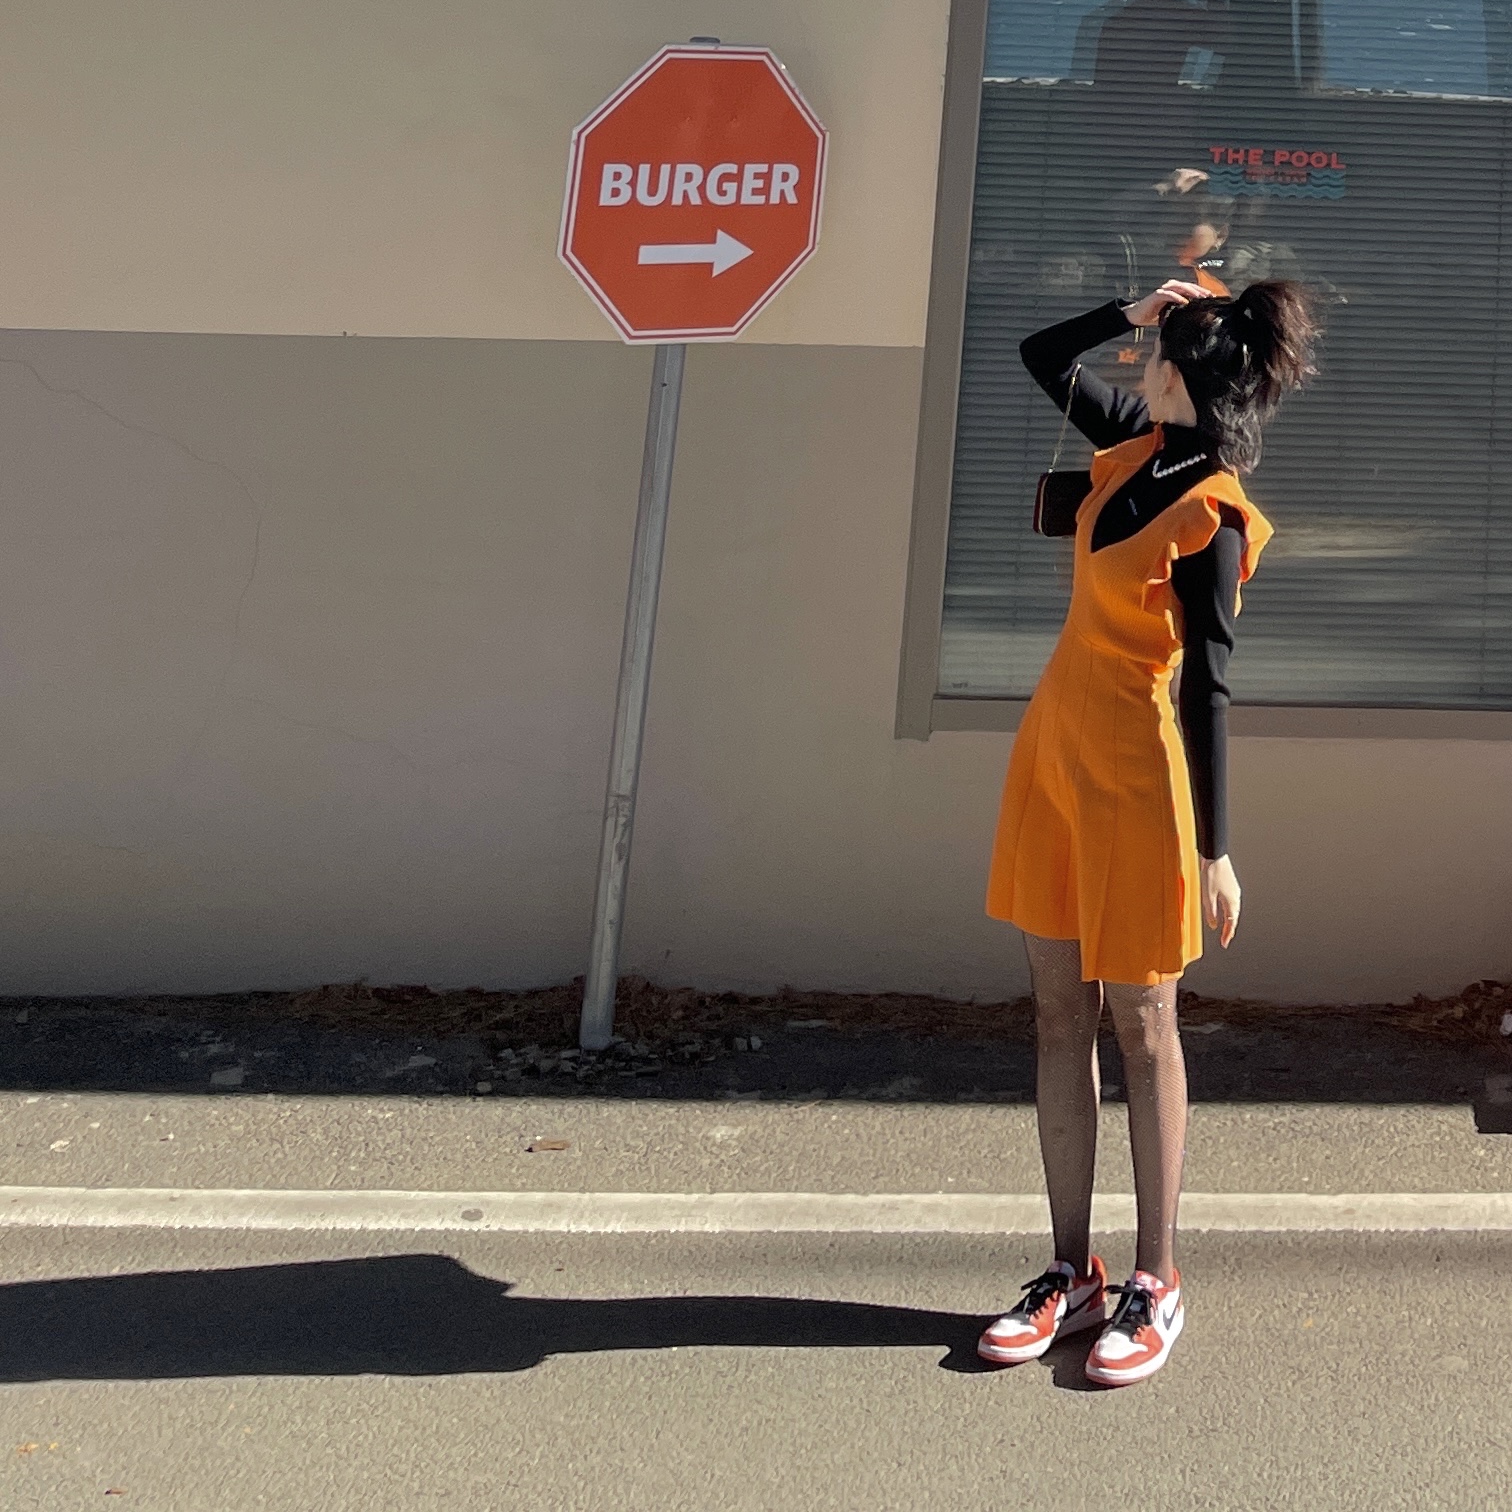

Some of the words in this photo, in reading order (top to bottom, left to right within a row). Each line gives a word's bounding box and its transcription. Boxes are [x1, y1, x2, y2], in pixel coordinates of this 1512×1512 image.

[1209, 146, 1264, 165] THE
[1274, 149, 1346, 169] POOL
[598, 163, 800, 207] BURGER
